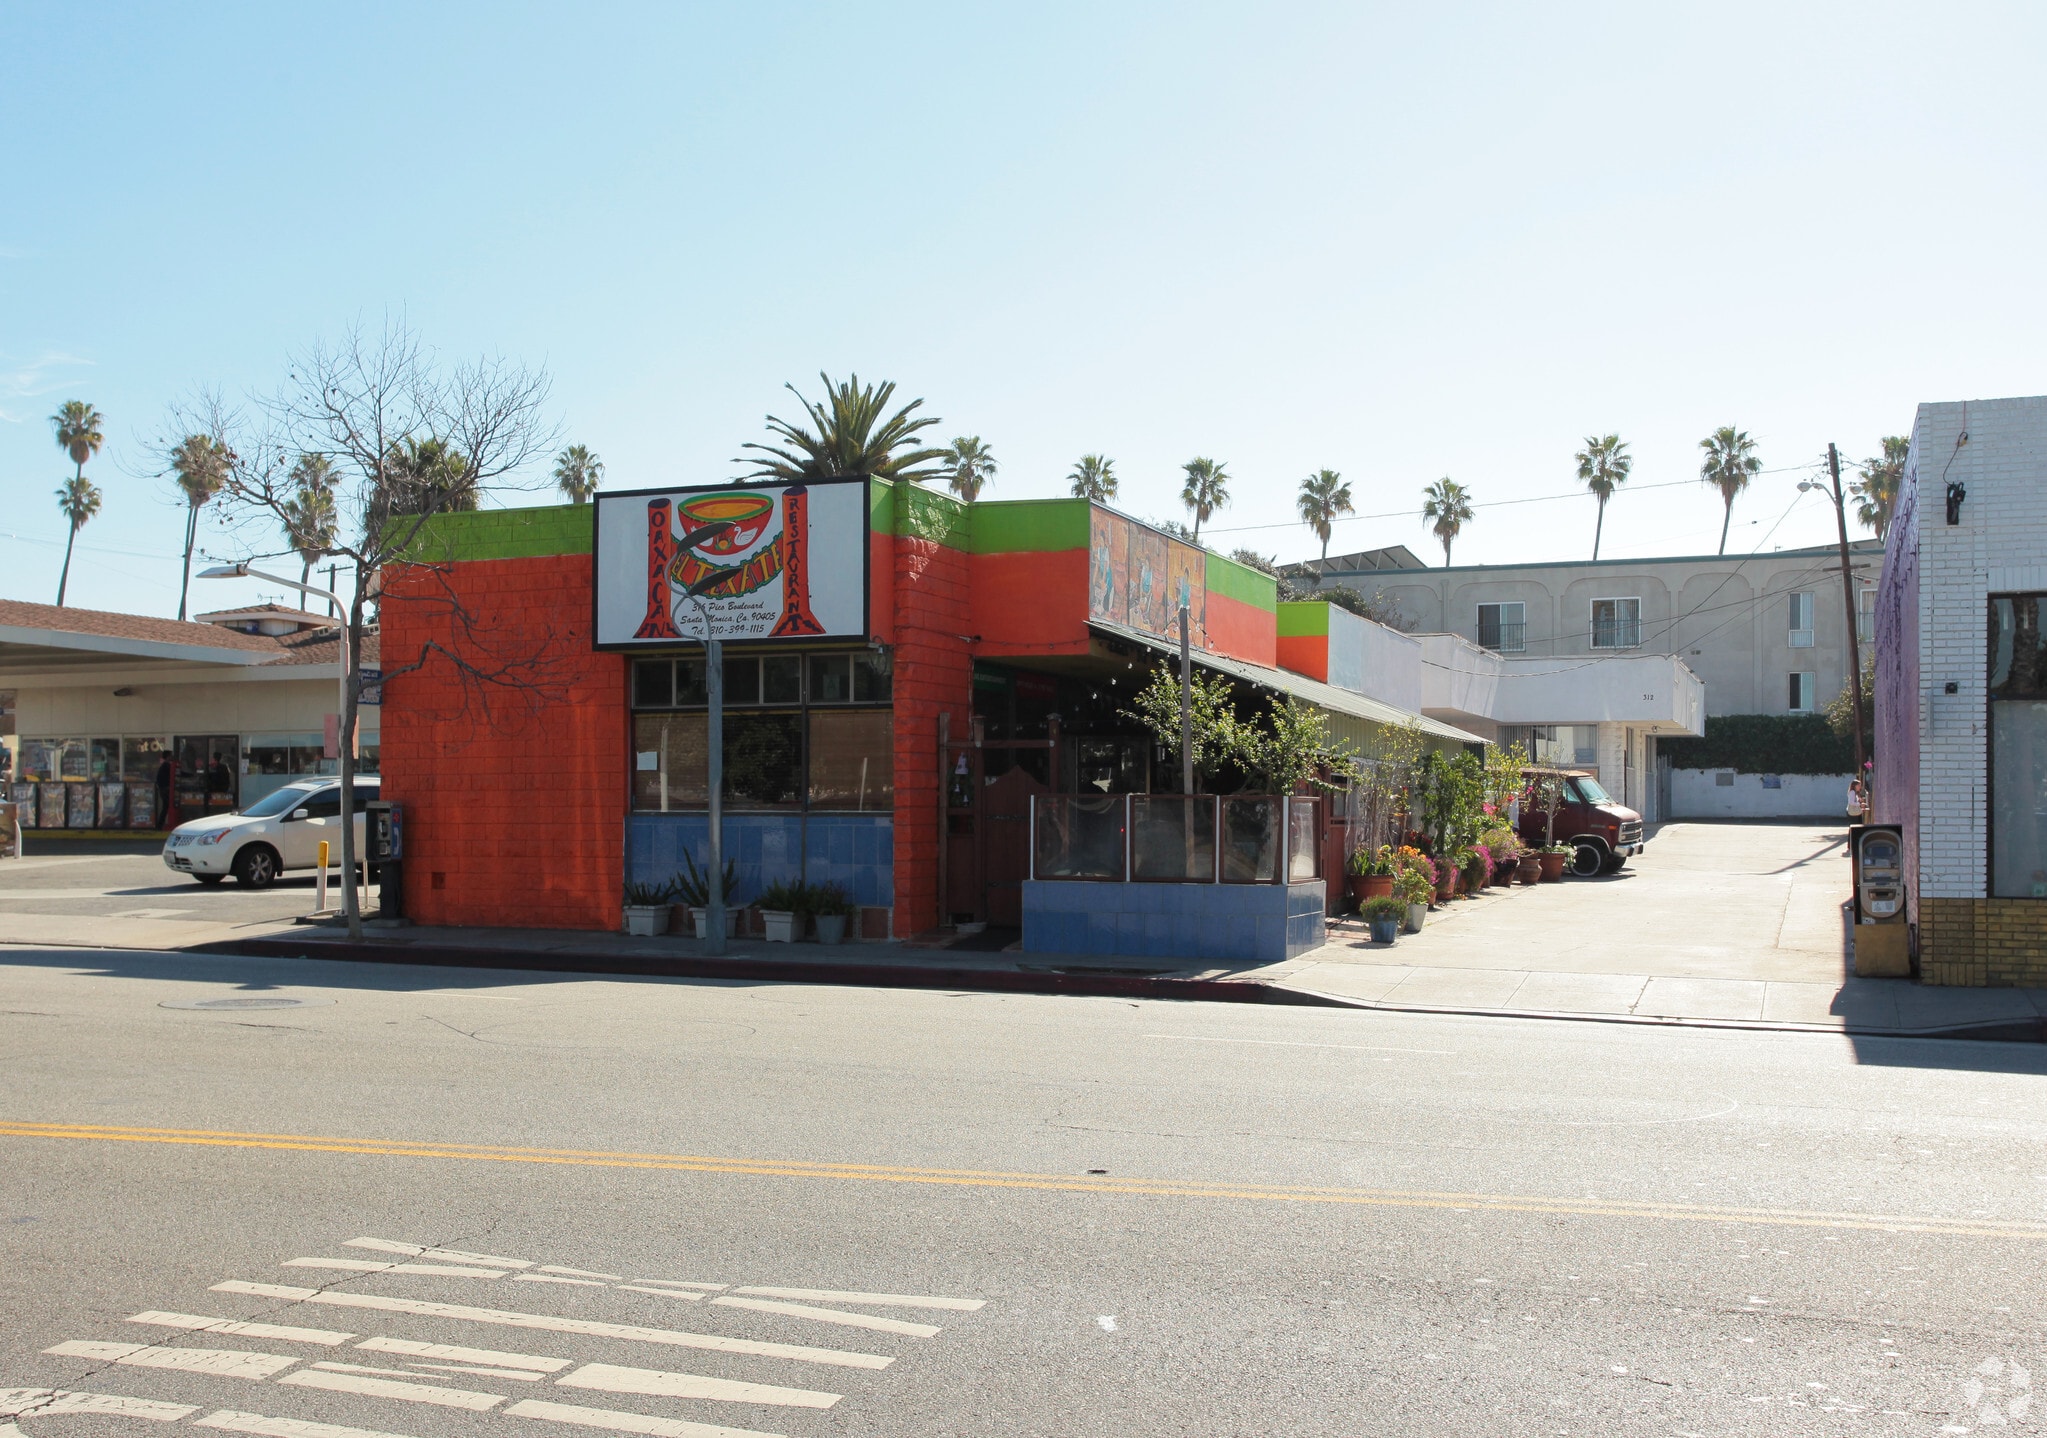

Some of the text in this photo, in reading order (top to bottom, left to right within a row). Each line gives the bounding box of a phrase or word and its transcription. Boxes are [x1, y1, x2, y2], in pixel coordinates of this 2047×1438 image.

[648, 511, 668, 638] OAXACAN
[672, 551, 690, 580] EL
[786, 499, 800, 631] RESTAURANT
[692, 601, 764, 612] 316 Pico Boulevard
[680, 615, 702, 625] Santa
[751, 612, 776, 621] 90405
[710, 625, 764, 635] 310-399-1115
